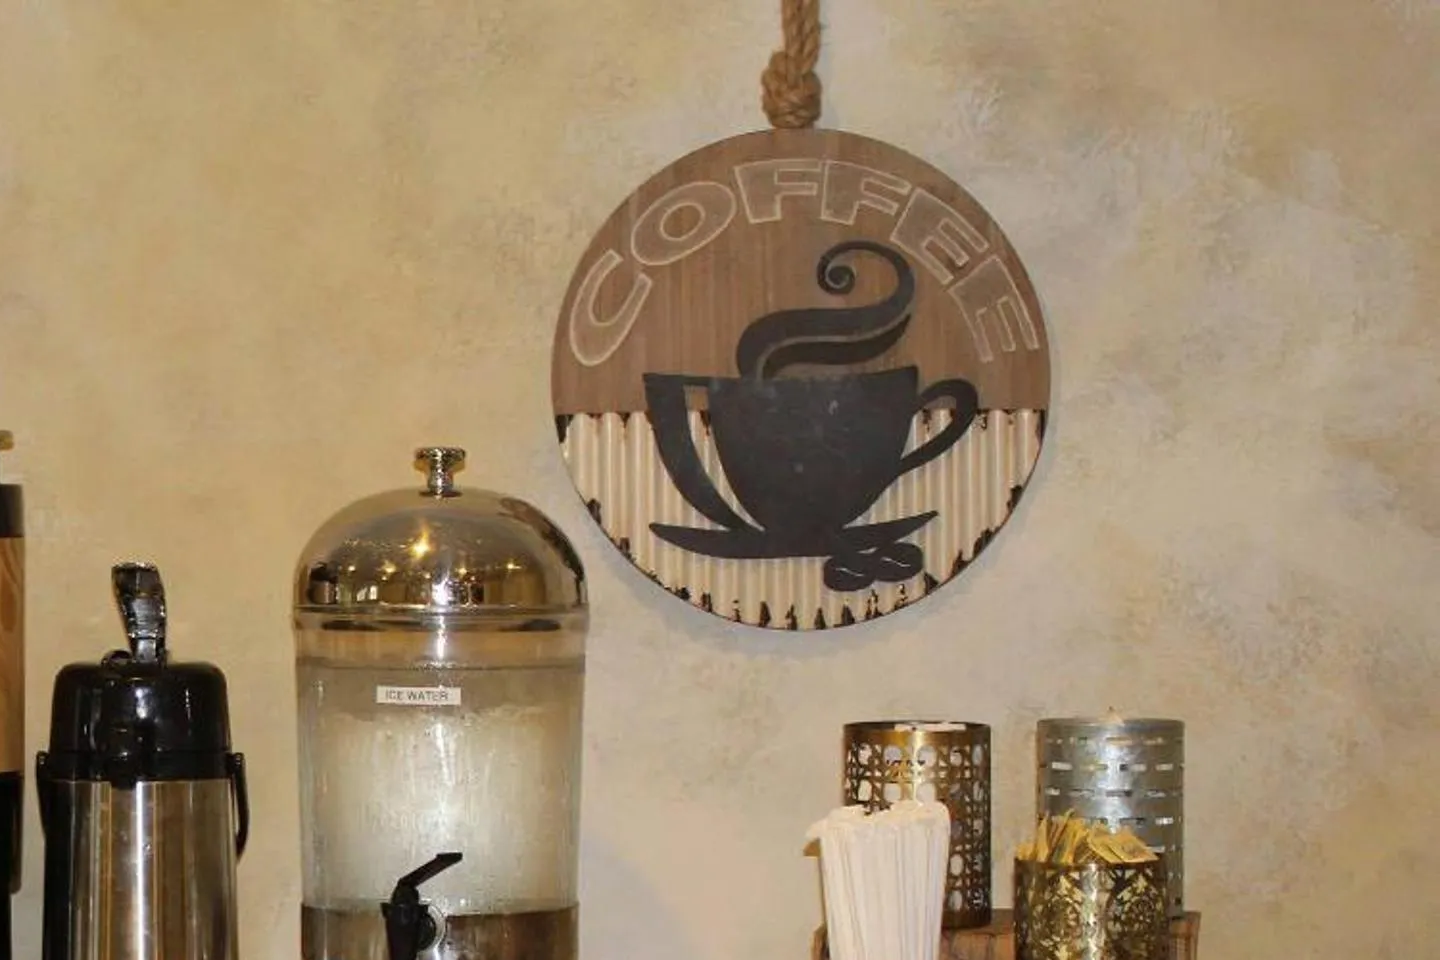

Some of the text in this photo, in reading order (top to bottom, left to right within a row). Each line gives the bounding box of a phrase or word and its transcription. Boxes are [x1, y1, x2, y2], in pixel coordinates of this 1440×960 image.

[569, 159, 1040, 366] COFFEE
[385, 690, 449, 701] ICE WATER
